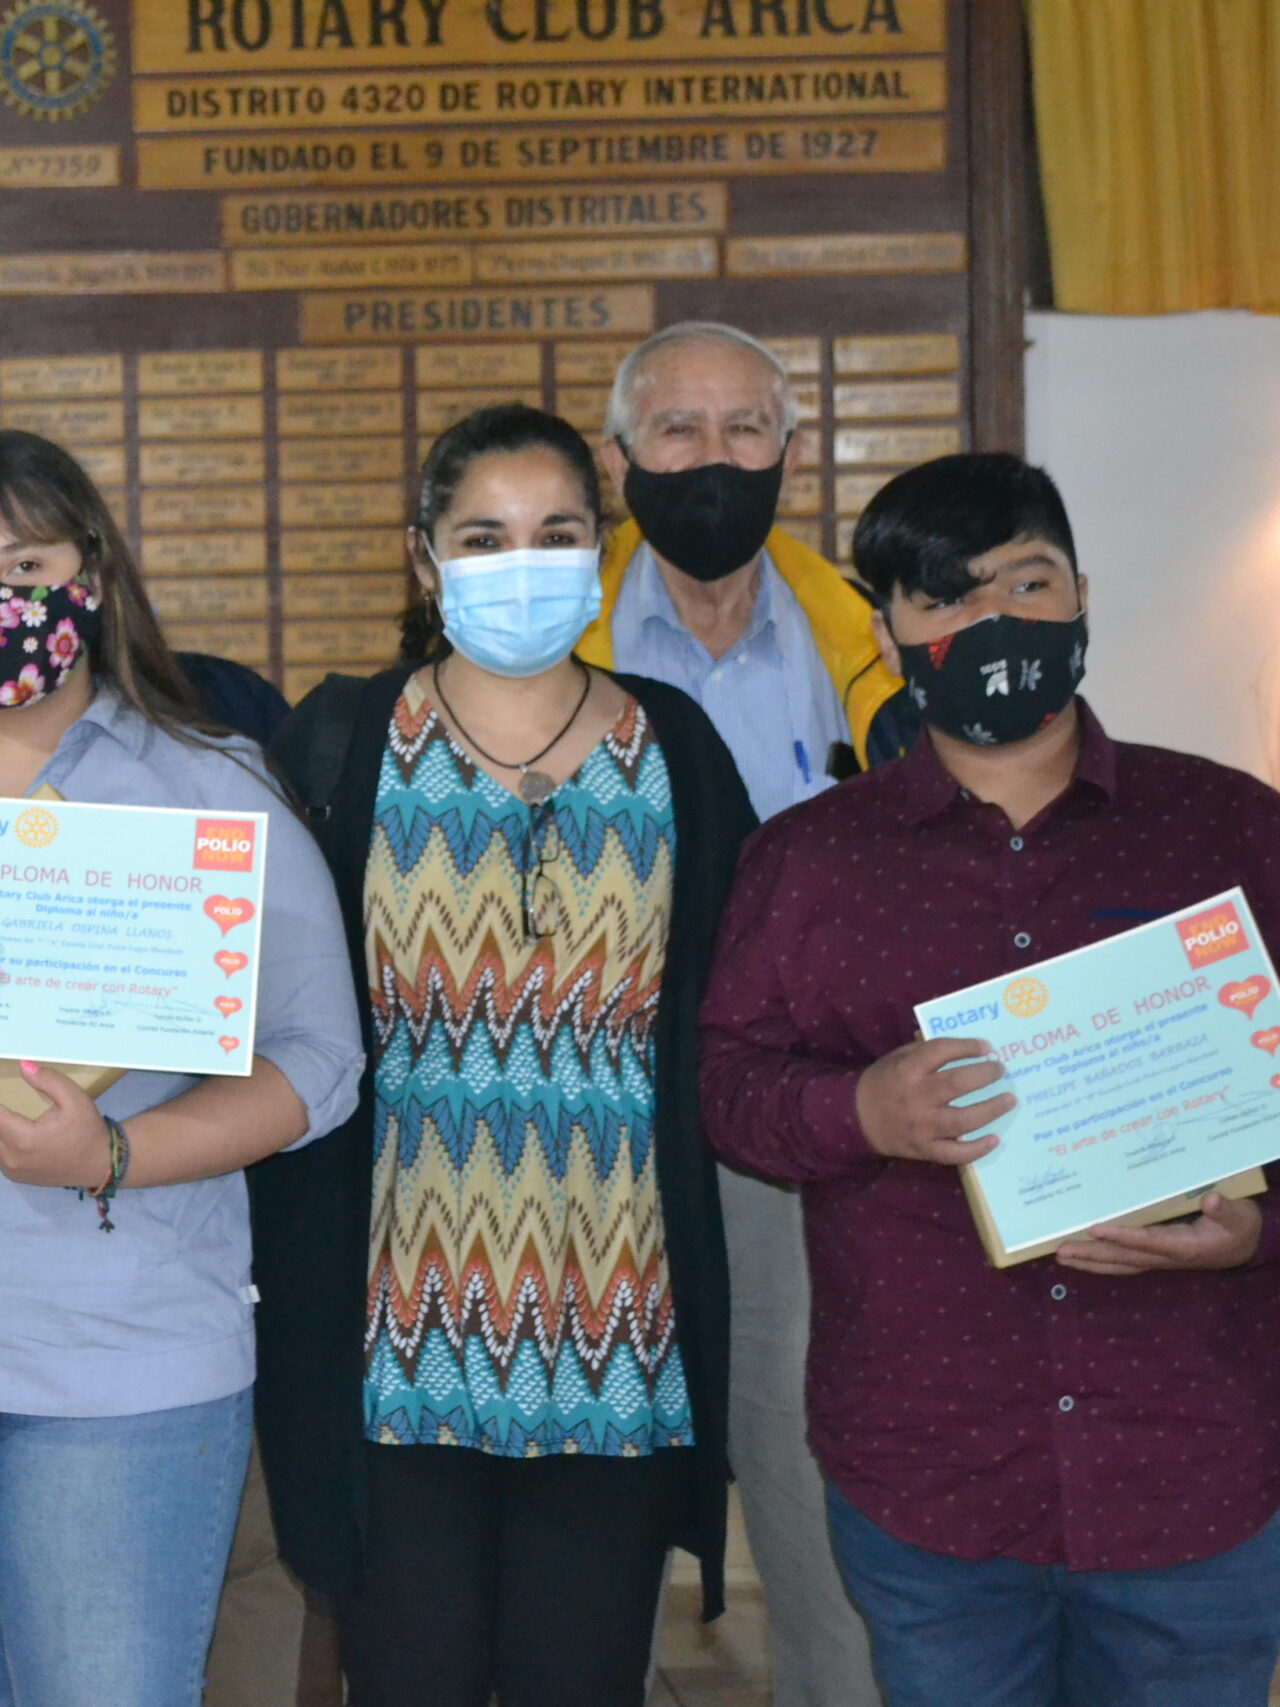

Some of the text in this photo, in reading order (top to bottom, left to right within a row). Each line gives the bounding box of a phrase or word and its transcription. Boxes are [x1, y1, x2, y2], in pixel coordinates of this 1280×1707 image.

[486, 0, 666, 46] CLUB
[700, 0, 904, 39] ARICA
[167, 70, 910, 119] DISTRITO 4320 DE ROTARY INTERNATIONAL
[203, 129, 880, 176] FUNDADO EL 9 DE SEPTIEMBRE DE 1927
[241, 192, 708, 235] GOBERNADORES DISTRITALES
[343, 295, 612, 331] PRESIDENTES
[197, 838, 251, 853] POLIO
[85, 870, 112, 887] DE
[127, 872, 203, 893] HONOR
[26, 891, 51, 901] Club
[55, 893, 84, 904] Arica
[87, 896, 124, 907] otorga
[128, 898, 139, 906] el
[141, 899, 192, 911] presente
[35, 904, 139, 921] Diploma al niño/a
[213, 907, 243, 916] POLIO
[1185, 921, 1239, 951] POLIO
[9, 956, 22, 965] su
[26, 957, 100, 971] participación
[103, 964, 117, 973] en
[121, 964, 131, 973] el
[134, 965, 187, 977] Concurso
[0, 973, 11, 984] El
[15, 975, 41, 987] arte
[45, 977, 61, 988] de
[65, 980, 98, 991] crear
[102, 982, 125, 993] con
[1229, 985, 1259, 1003] POLIO
[929, 1001, 1000, 1035] Rotary
[985, 975, 1212, 1063] DIPLOMA DE HONOR
